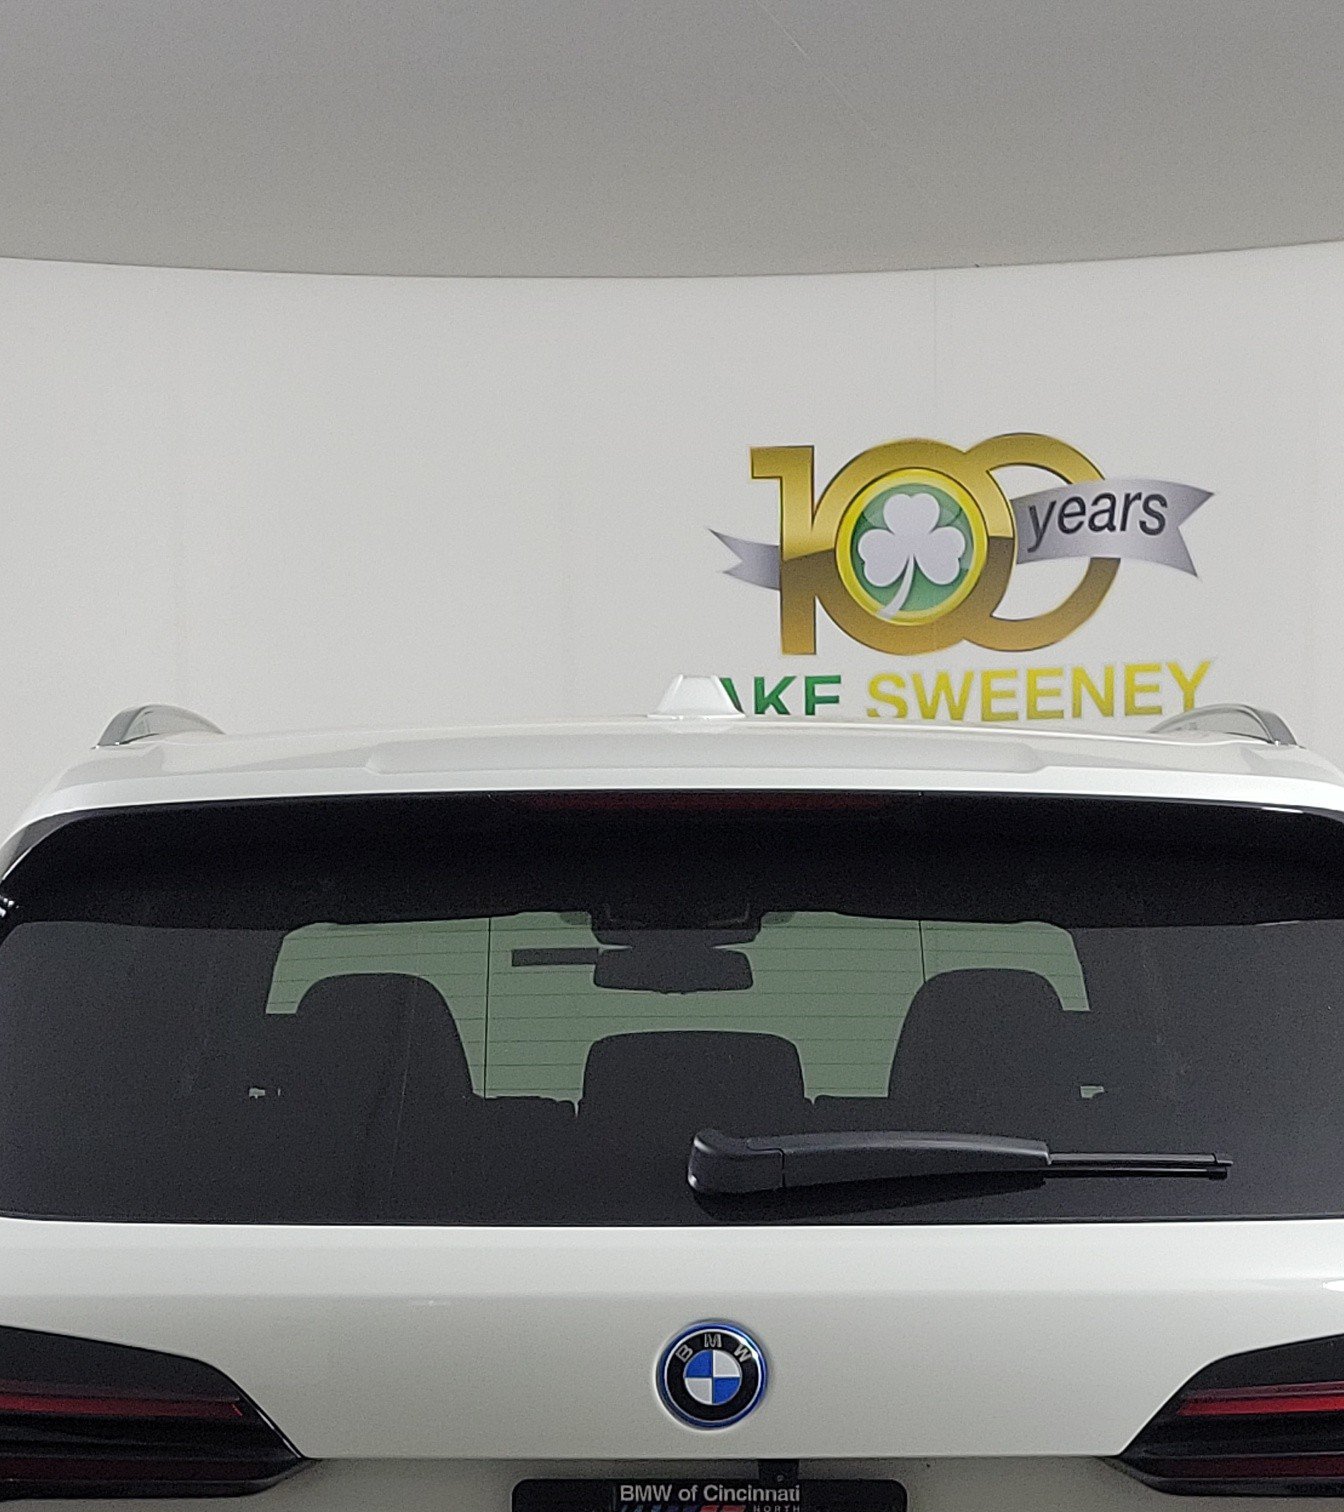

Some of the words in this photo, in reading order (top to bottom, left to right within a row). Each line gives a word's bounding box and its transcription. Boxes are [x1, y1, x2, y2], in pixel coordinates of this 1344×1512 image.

[1027, 486, 1169, 553] years
[866, 660, 1213, 721] SWEENEY
[675, 1333, 753, 1363] BMW
[620, 1484, 672, 1502] BMW
[678, 1484, 698, 1502] of
[703, 1484, 801, 1502] Cincinnati
[753, 1505, 801, 1512] NORTH
